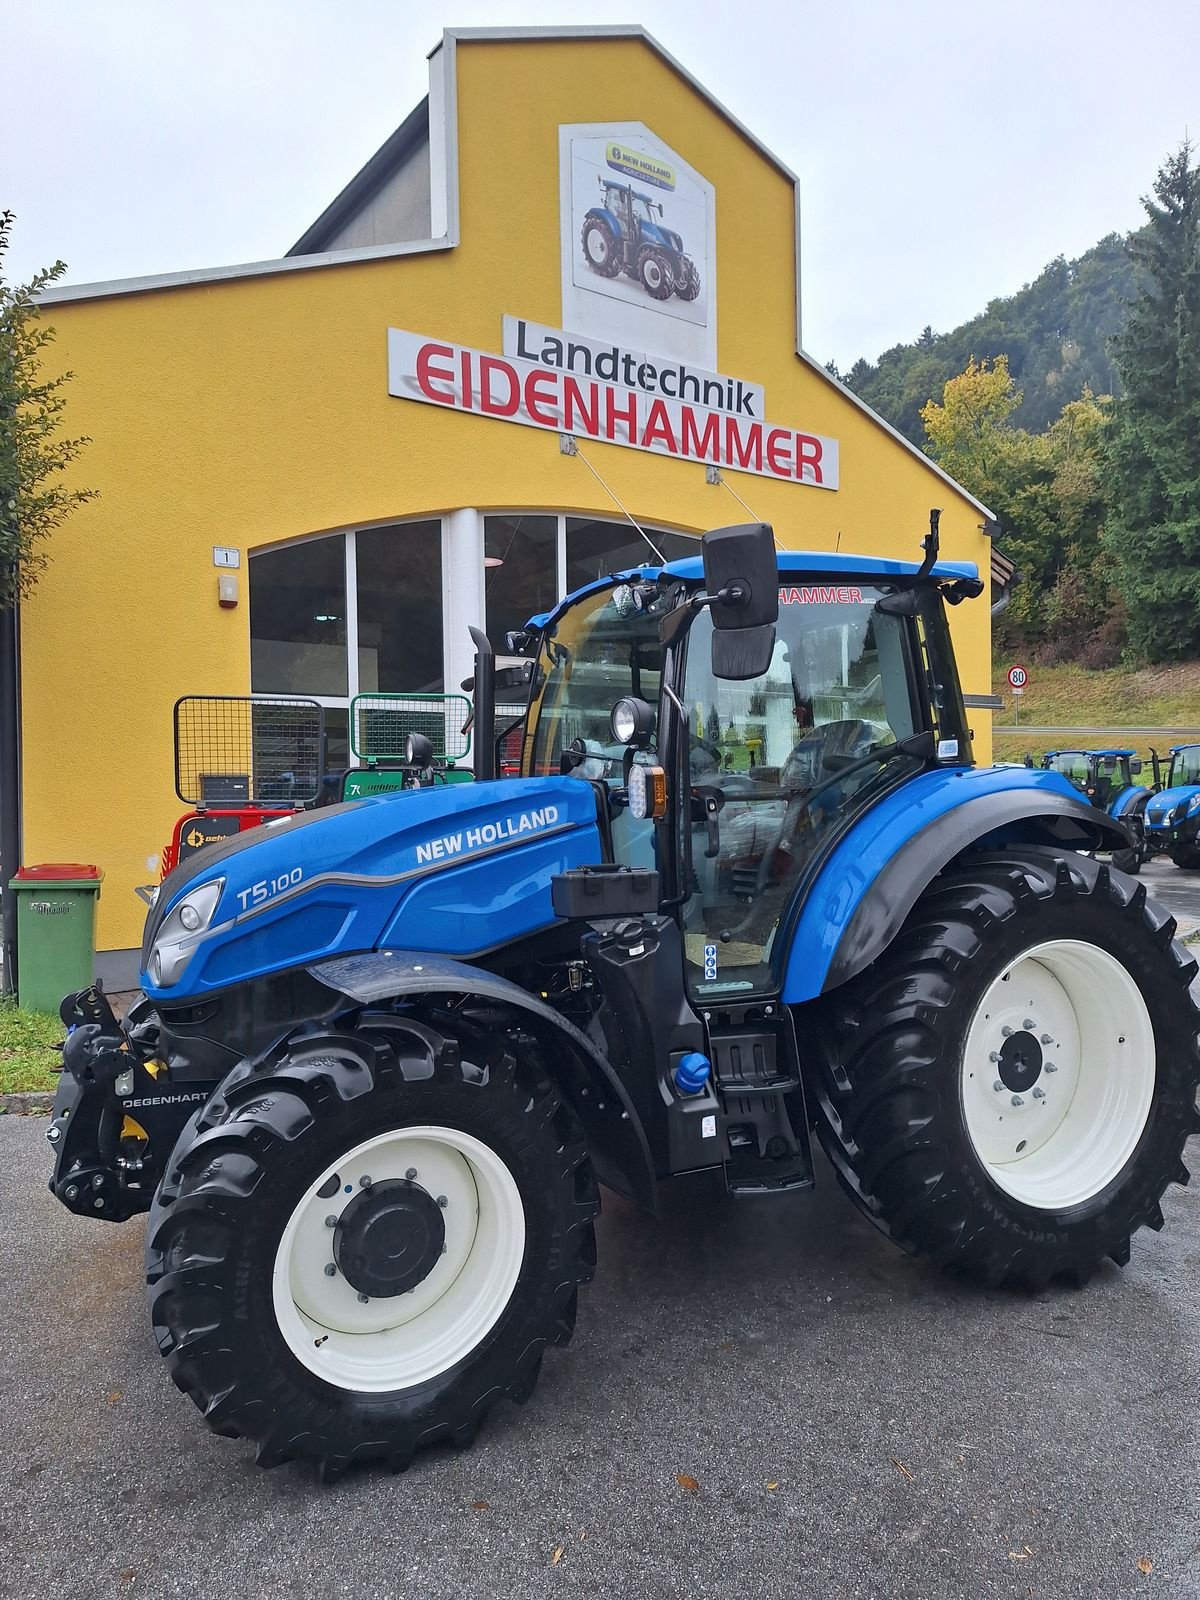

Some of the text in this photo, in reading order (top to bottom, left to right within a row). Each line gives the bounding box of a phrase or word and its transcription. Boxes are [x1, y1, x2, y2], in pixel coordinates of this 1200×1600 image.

[622, 153, 671, 179] NEW HOLLAND
[517, 320, 756, 416] Landtechnik
[416, 343, 824, 484] EIDENHAMMER
[224, 552, 229, 563] 1
[1012, 671, 1024, 683] 80
[416, 806, 559, 864] NEW HOLLAND
[237, 867, 303, 910] T5.100
[122, 1092, 209, 1108] DEGENHART
